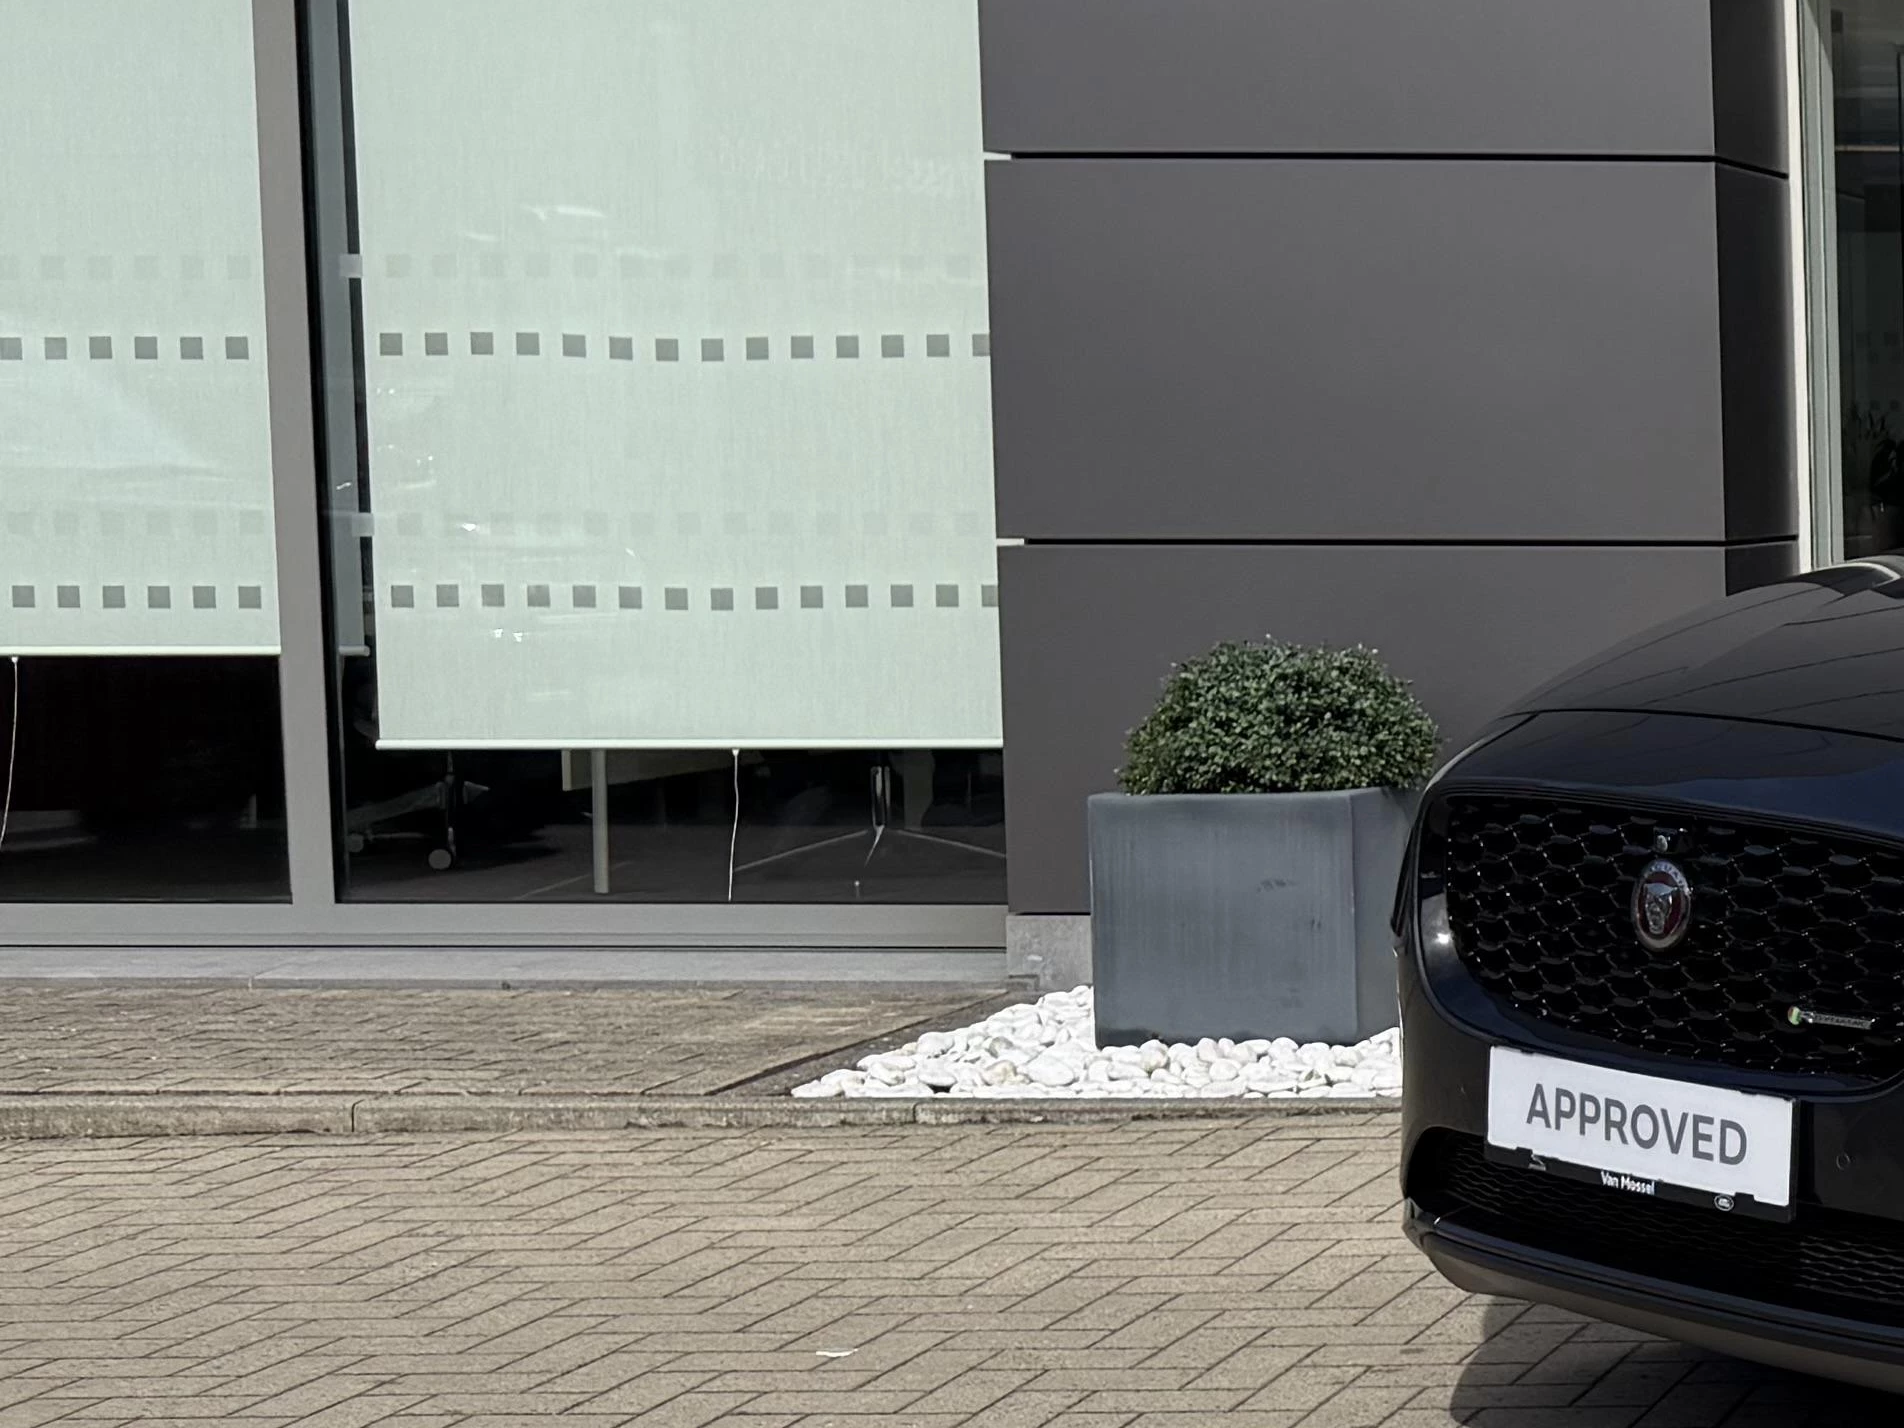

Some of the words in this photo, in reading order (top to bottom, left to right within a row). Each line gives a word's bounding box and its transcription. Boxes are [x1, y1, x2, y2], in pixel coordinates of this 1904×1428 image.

[1526, 1083, 1748, 1166] APPROVED
[1600, 1170, 1619, 1188] Van
[1620, 1175, 1655, 1195] Mossel
